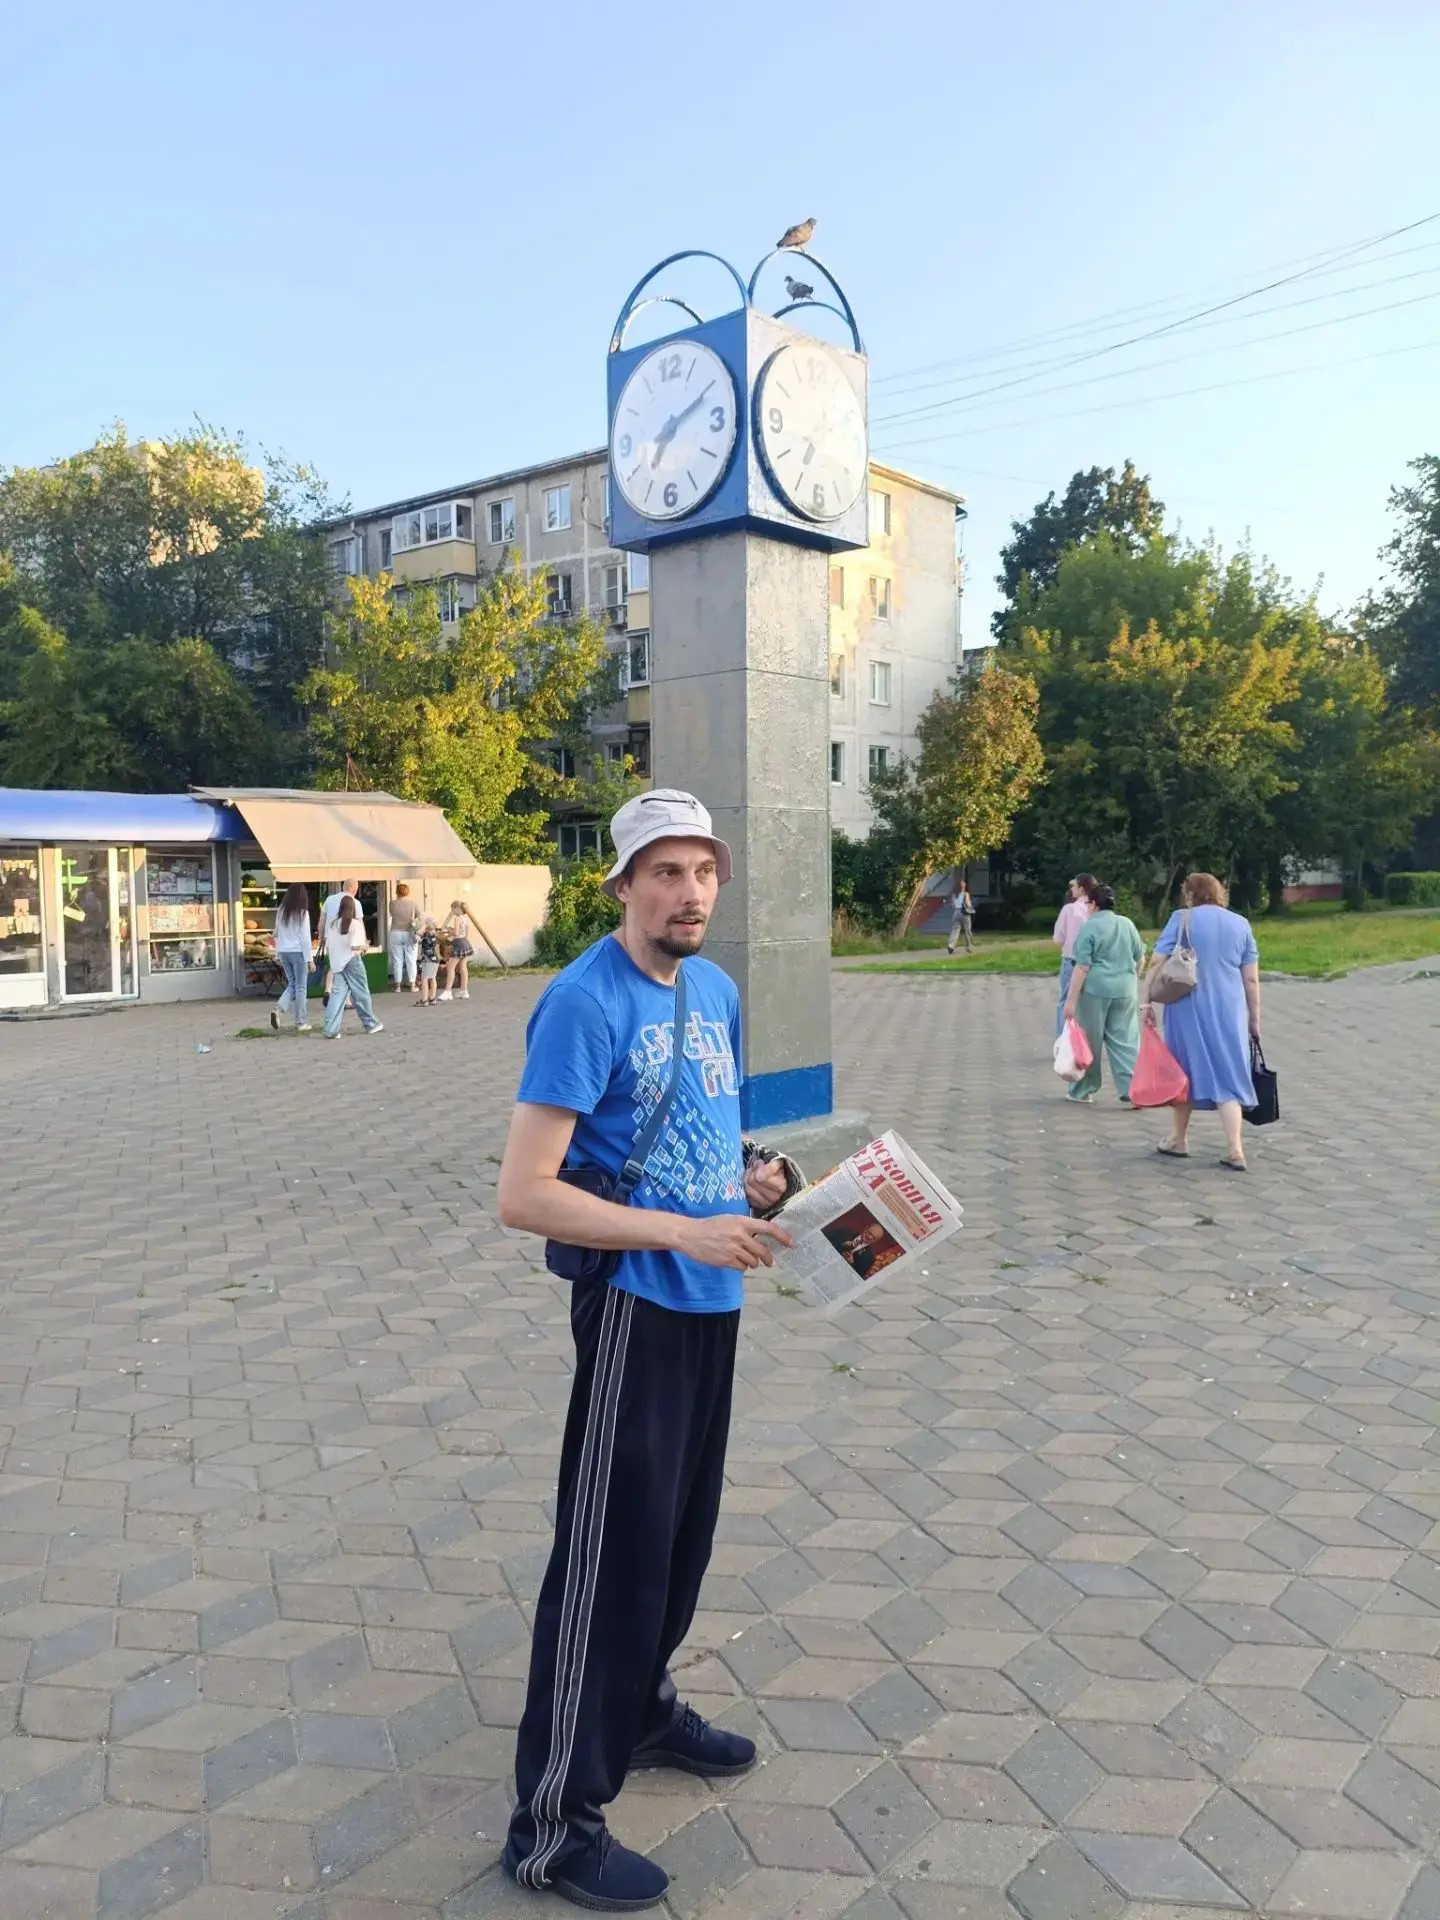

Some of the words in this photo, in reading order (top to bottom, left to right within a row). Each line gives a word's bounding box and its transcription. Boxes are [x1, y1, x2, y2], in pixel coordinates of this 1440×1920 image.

[657, 354, 682, 383] 12
[709, 406, 725, 433] 3
[769, 407, 783, 434] 9
[618, 433, 633, 459] 9
[663, 482, 678, 508] 6
[812, 483, 825, 510] 6
